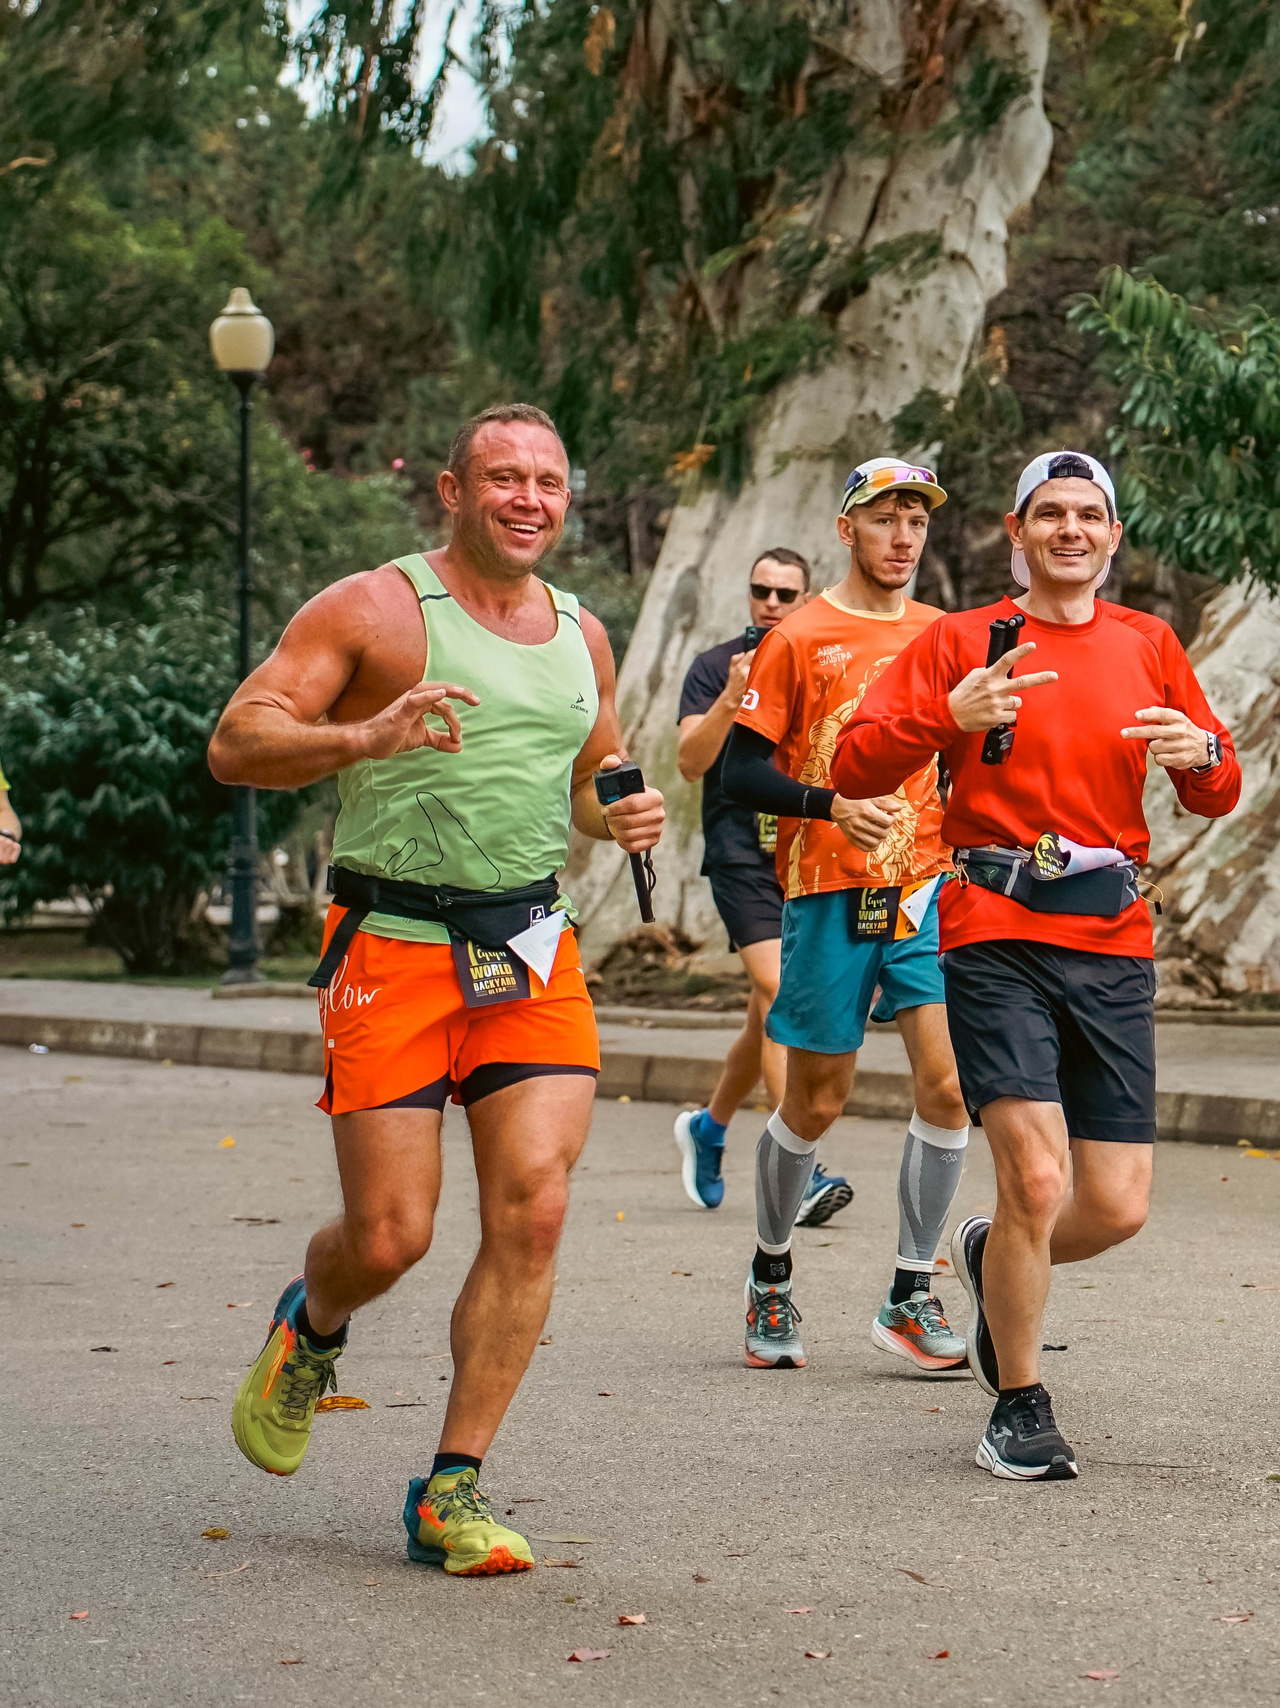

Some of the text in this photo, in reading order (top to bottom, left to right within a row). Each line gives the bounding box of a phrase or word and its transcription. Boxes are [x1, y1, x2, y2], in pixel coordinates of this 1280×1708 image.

[858, 909, 888, 920] WORLD
[857, 921, 888, 930] BACKYARD
[469, 963, 513, 980] WORLD
[473, 976, 517, 992] BACKYARD
[488, 987, 507, 995] ULTRA
